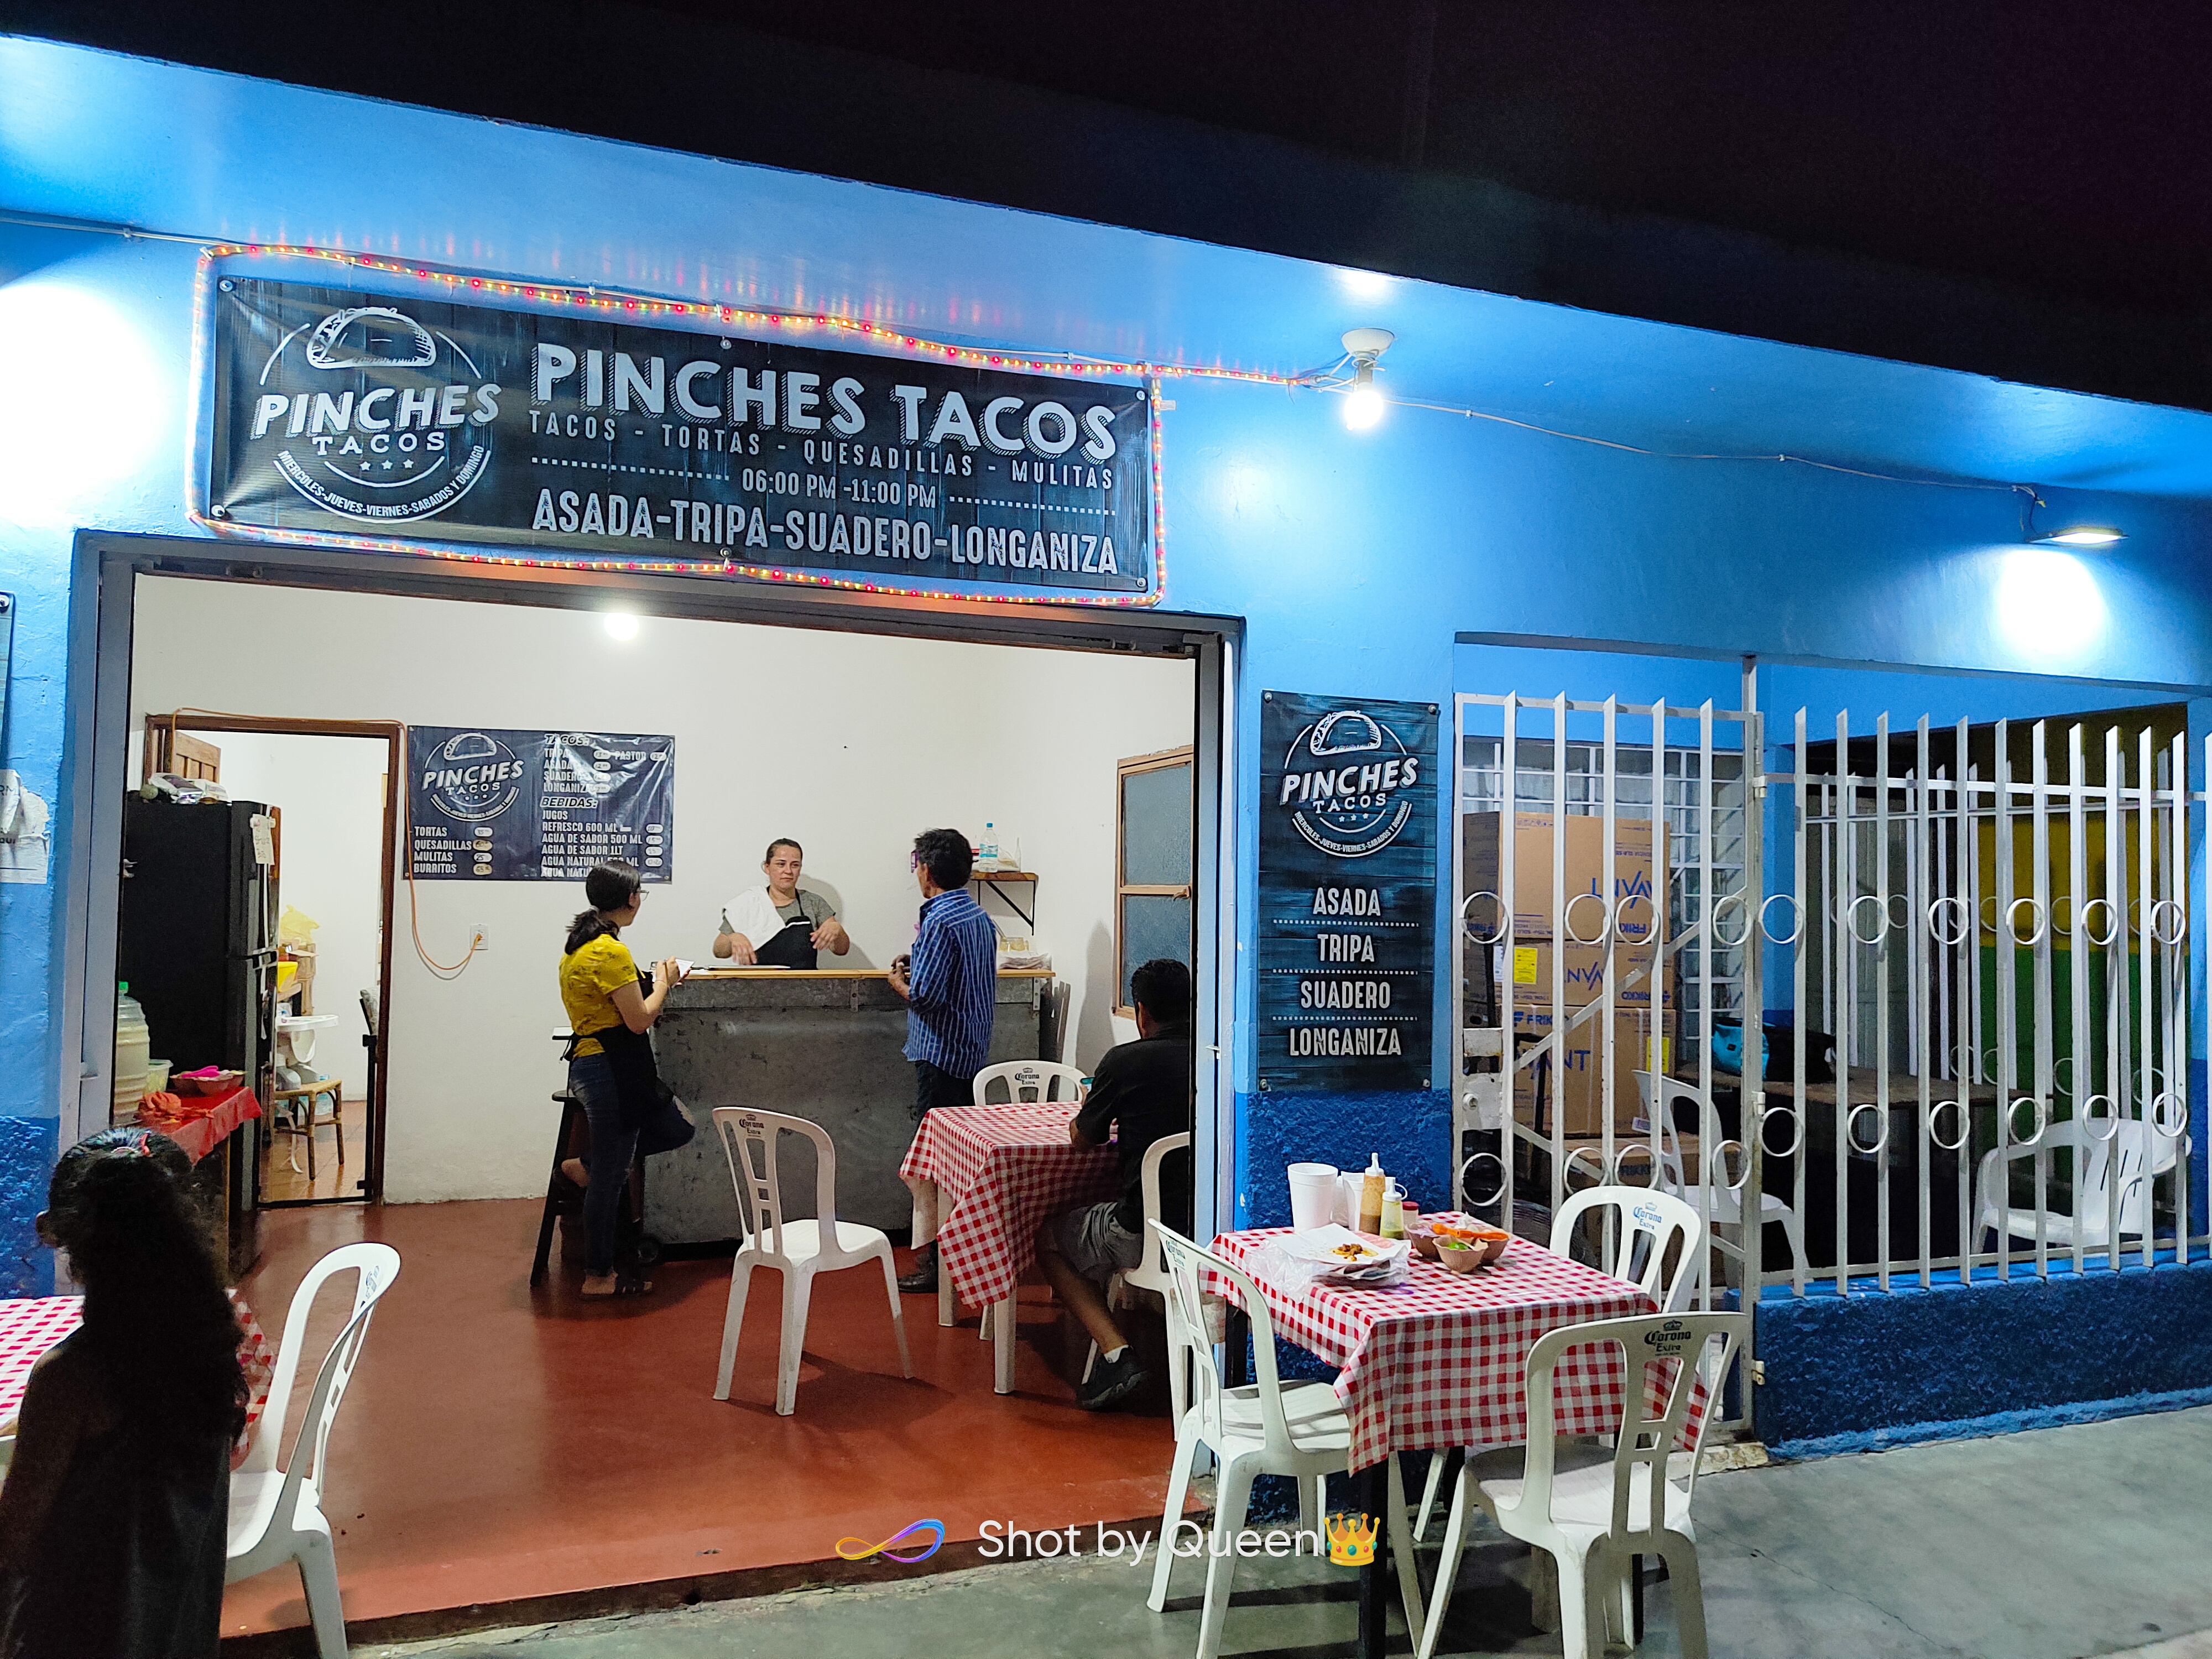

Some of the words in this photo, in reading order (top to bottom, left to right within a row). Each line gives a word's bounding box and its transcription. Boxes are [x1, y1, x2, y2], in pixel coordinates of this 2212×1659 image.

[251, 383, 502, 440] PINCHES
[530, 343, 865, 439] PINCHES
[890, 384, 1116, 465] TACOS
[312, 431, 446, 456] TACOS
[529, 410, 615, 440] TACOS
[661, 424, 760, 455] TORTAS
[804, 439, 972, 476] QUESADILLAS
[1012, 460, 1112, 489] MULITAS
[456, 445, 484, 484] DOMINGO
[742, 468, 800, 495] 06:00
[806, 473, 836, 499] PM
[907, 484, 936, 508] PM
[421, 760, 524, 791] PINCHES
[1279, 757, 1418, 806] PINCHES
[445, 782, 500, 795] TACOS
[541, 797, 597, 808] BEBIDAS:
[1313, 793, 1386, 813] TACOS
[542, 810, 568, 820] JUGOS
[1391, 800, 1408, 828] DOMINGO
[414, 826, 447, 837] TORTAS
[542, 822, 583, 832] REFRESCO
[586, 823, 602, 832] 600
[605, 823, 618, 832] ML
[414, 839, 472, 851] QUESADILLAS
[542, 833, 565, 843] AGUA
[567, 833, 578, 843] DE
[580, 834, 608, 844] SABOR
[611, 834, 627, 844] 500
[629, 834, 643, 844] ML
[414, 852, 453, 862] MULITAS
[541, 845, 565, 854] AGUA
[567, 845, 577, 855] DE
[580, 846, 608, 855] SABOR
[414, 863, 457, 873] BURRITOS
[541, 856, 565, 866] AGUA
[626, 857, 639, 867] ML
[567, 868, 590, 878] NATU
[1313, 887, 1381, 916] ASADA
[1317, 933, 1375, 962] TRIPA
[1300, 980, 1391, 1009] SUADERO
[1290, 1027, 1402, 1056] LONGANIZA
[739, 1118, 764, 1129] Corona
[1633, 1206, 1662, 1223] Corona
[1644, 1331, 1691, 1346] Corona
[1656, 1343, 1681, 1352] Extra
